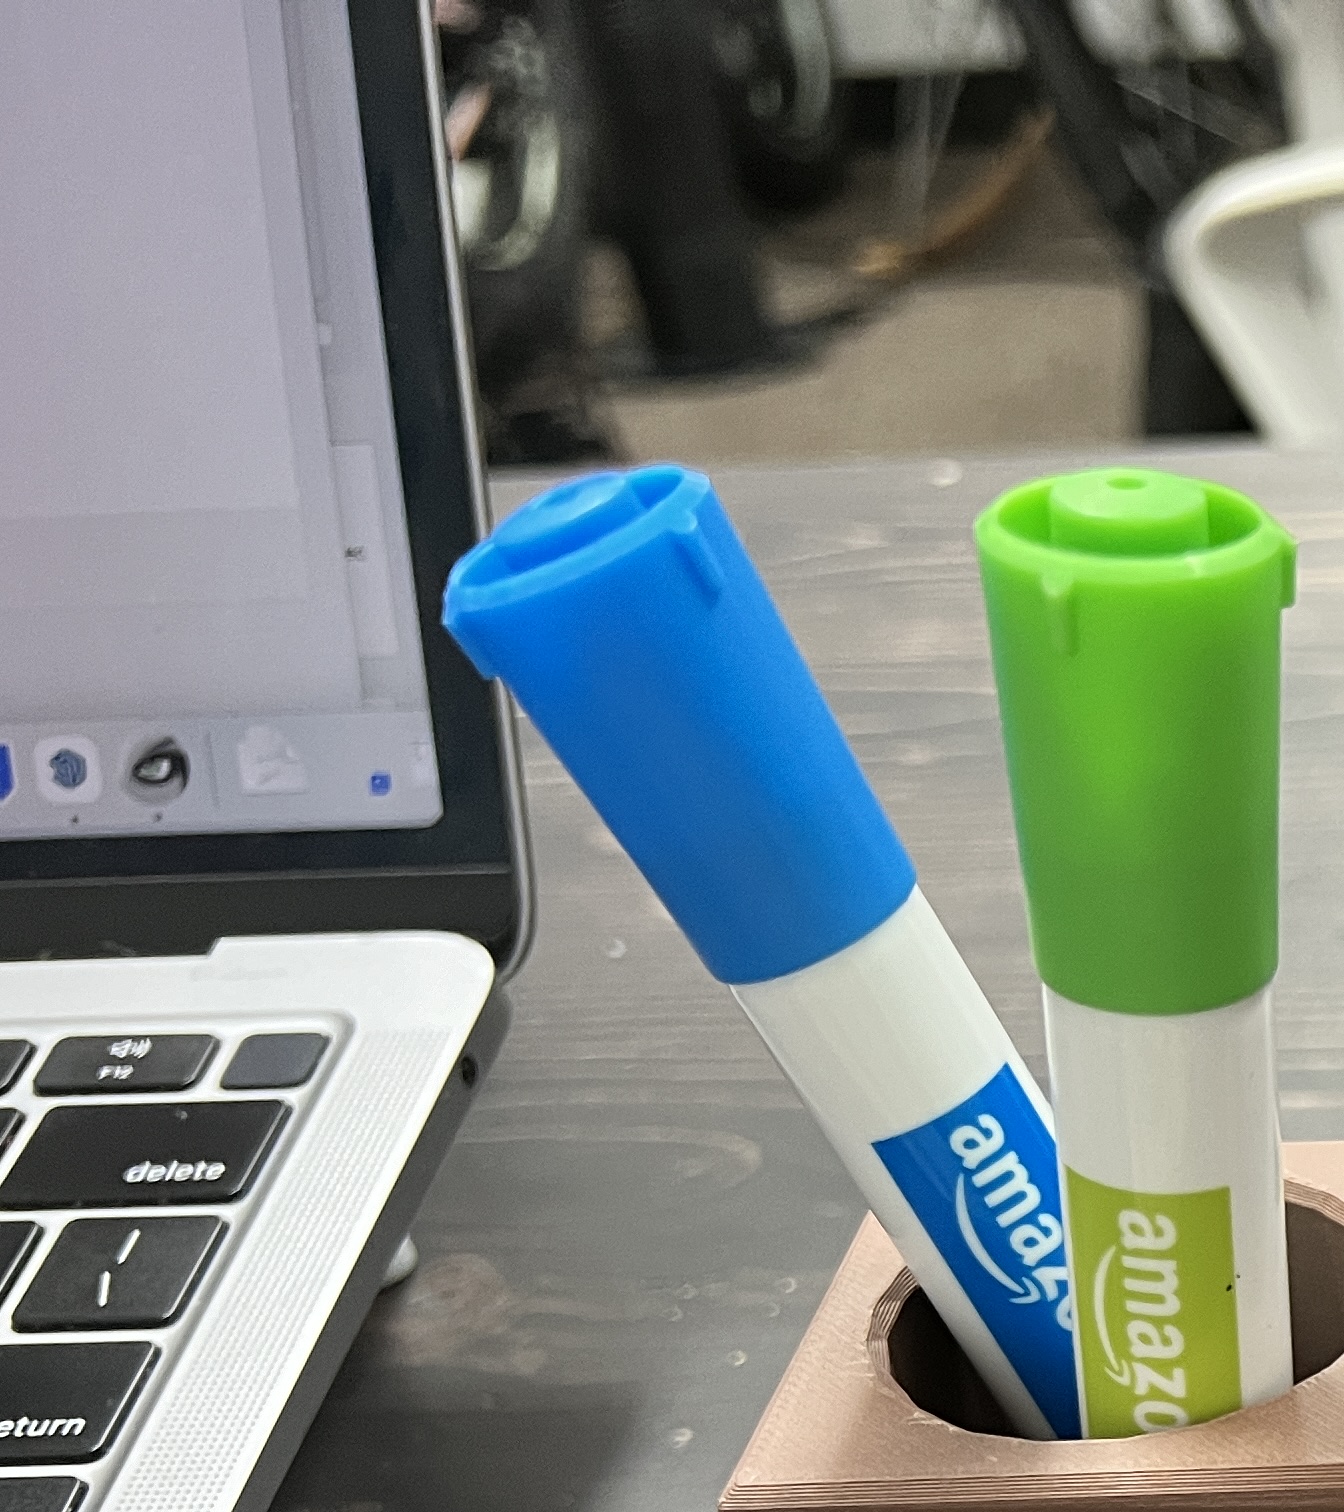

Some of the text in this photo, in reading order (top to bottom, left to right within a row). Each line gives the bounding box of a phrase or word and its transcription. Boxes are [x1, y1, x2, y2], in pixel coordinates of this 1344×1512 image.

[123, 1160, 226, 1184] delete
[1118, 1208, 1189, 1432] amazo
[0, 1416, 87, 1438] eturn
